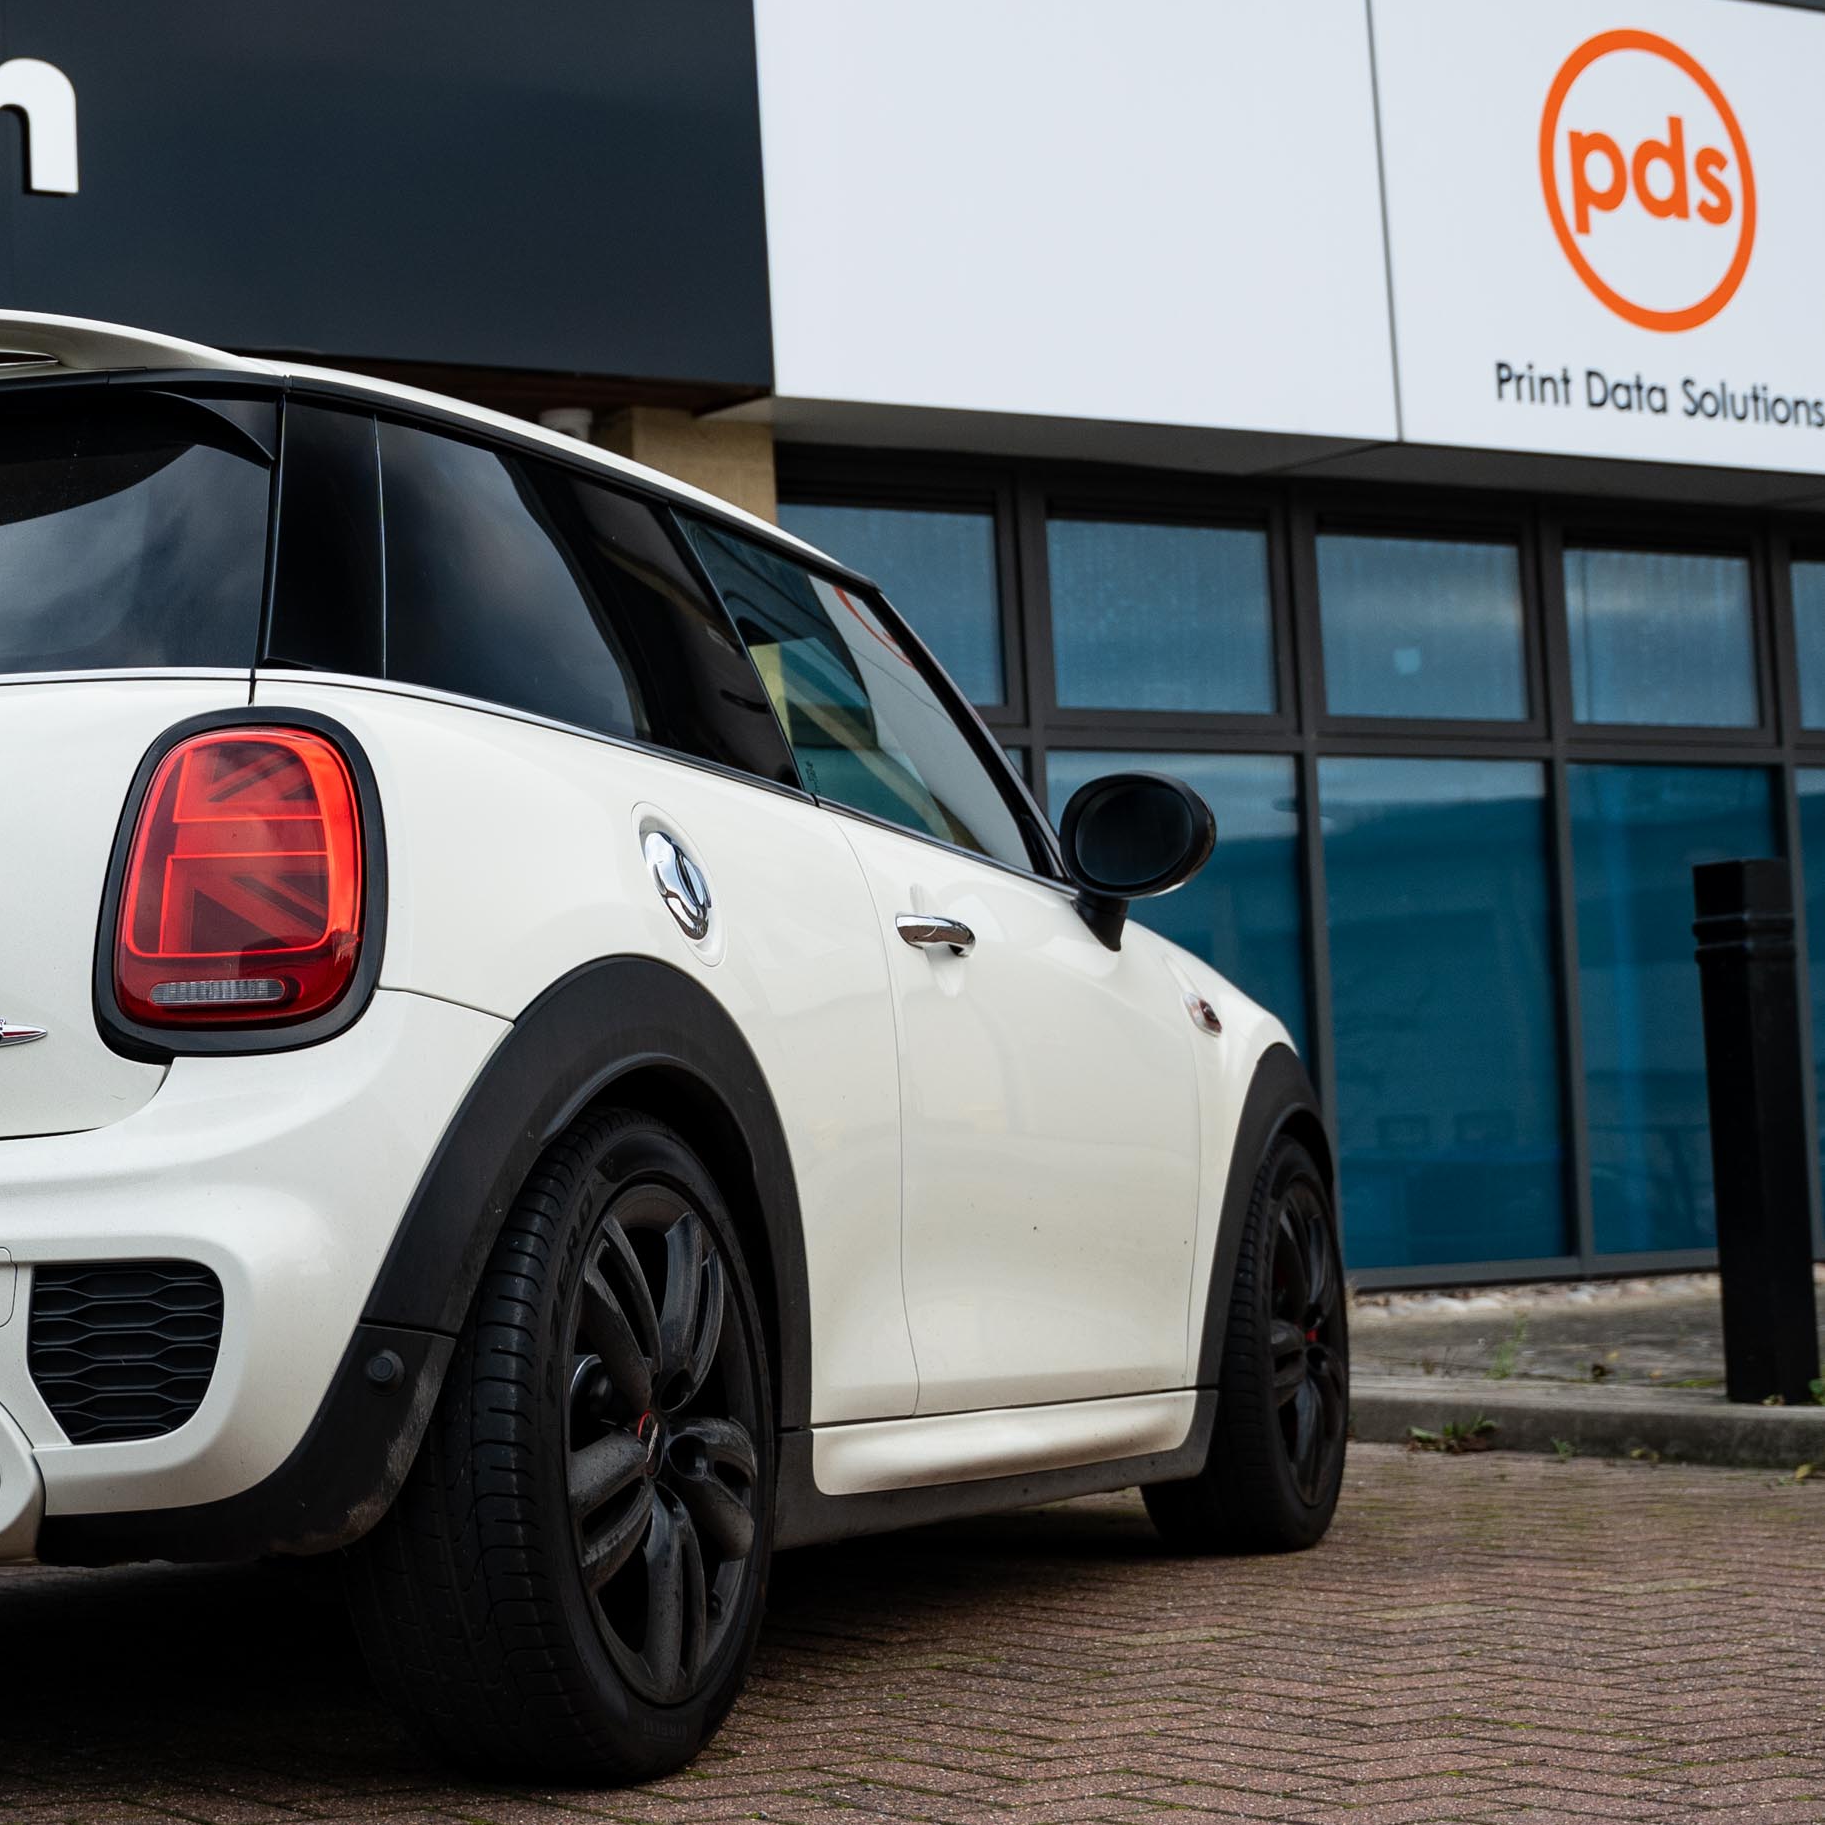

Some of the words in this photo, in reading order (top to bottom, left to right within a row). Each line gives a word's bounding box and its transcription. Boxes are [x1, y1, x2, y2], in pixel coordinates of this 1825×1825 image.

[1568, 115, 1733, 235] pds
[1495, 361, 1571, 406] Print
[1585, 369, 1668, 415] Data
[1681, 377, 1825, 428] Solutions
